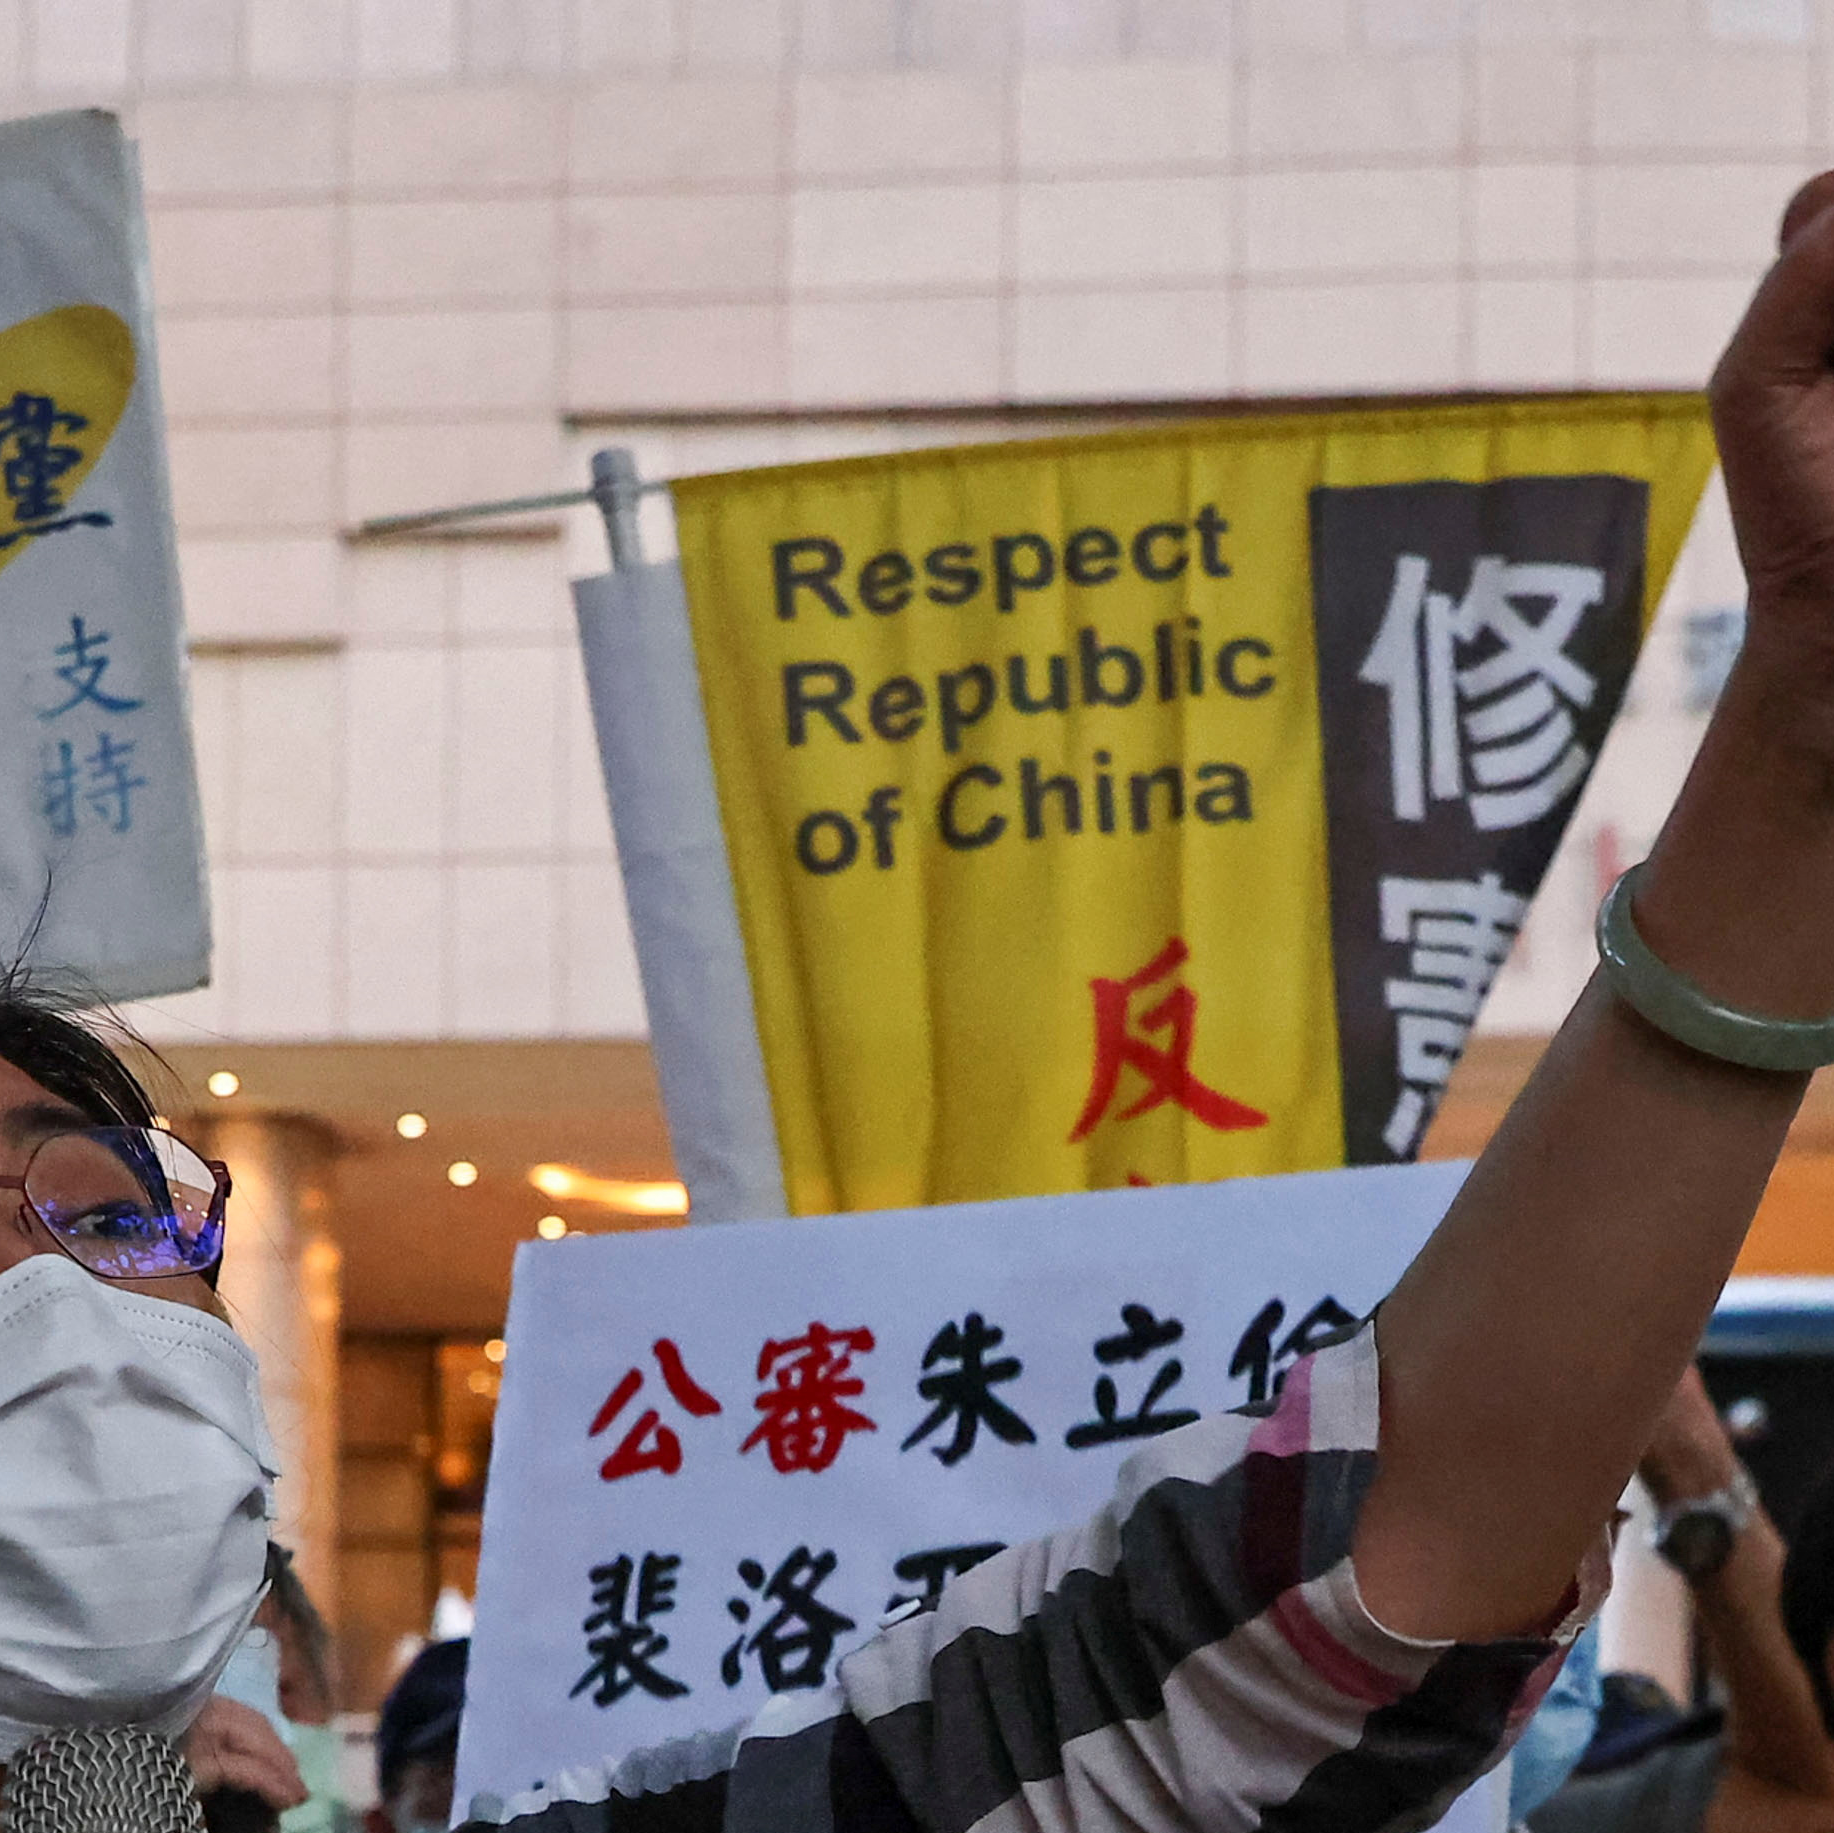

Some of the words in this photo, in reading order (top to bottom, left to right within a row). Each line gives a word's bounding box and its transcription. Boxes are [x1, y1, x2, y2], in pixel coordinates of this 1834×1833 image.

[771, 503, 1232, 620] Respect
[35, 616, 151, 836] 支持
[783, 614, 1277, 755] Republic
[795, 787, 905, 875] of
[935, 750, 1254, 855] China
[1067, 936, 1271, 1188] 反
